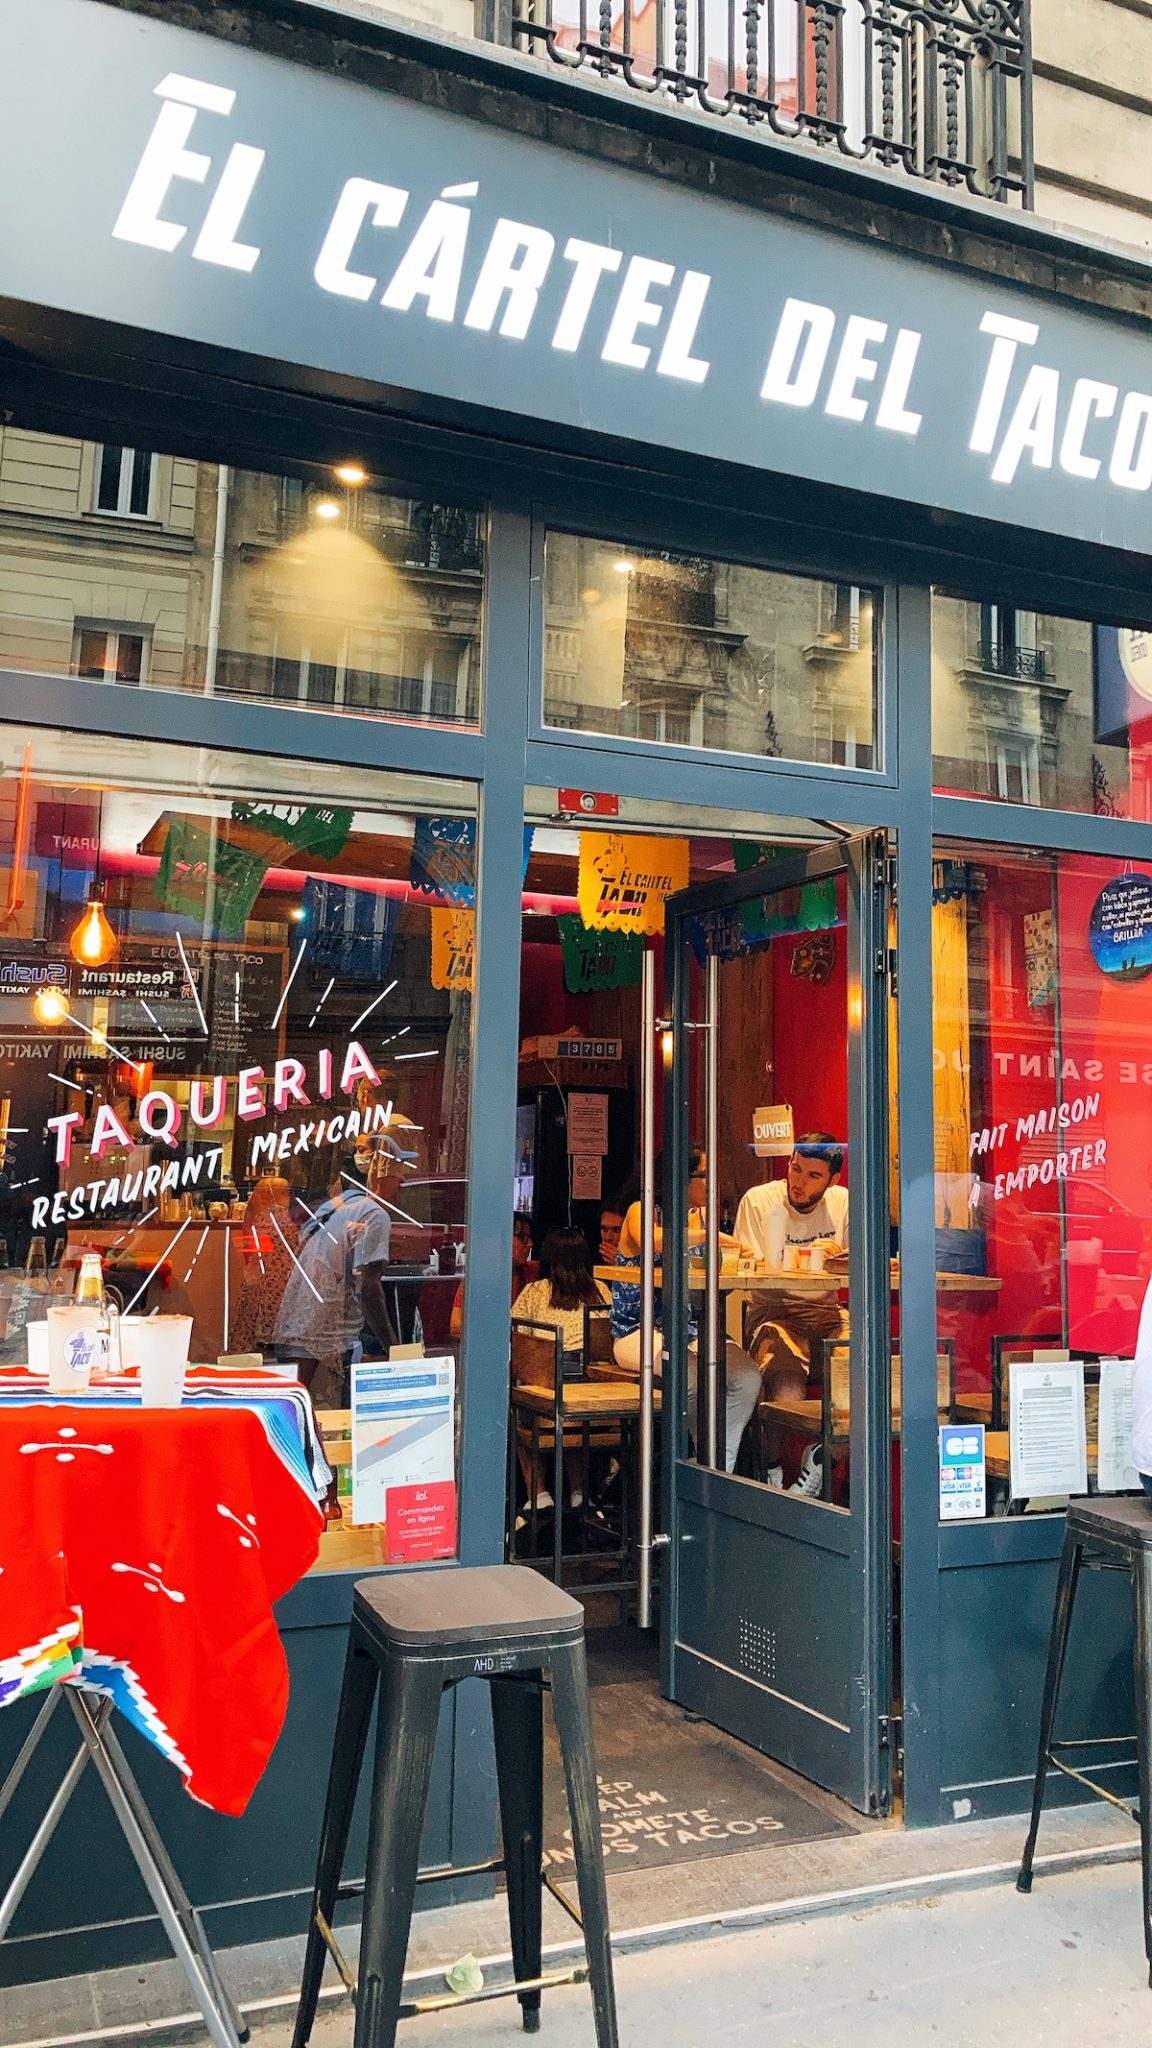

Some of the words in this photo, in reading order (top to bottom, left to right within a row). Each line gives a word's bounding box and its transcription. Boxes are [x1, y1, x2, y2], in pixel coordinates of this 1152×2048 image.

[112, 72, 266, 273] EL
[313, 180, 711, 384] CÁRTEL
[759, 297, 923, 436] DEL
[968, 310, 1152, 492] TACO
[572, 1043, 618, 1056] 3785
[48, 1041, 382, 1169] TAQUERIA
[754, 1121, 793, 1140] OUVERT
[969, 1123, 1008, 1158] FAIT
[1015, 1092, 1101, 1142] MAISON
[31, 1148, 224, 1229] RESTAURANT
[251, 1101, 394, 1168] MEXICAIN
[993, 1138, 1108, 1201] EMPORTER
[743, 1260, 751, 1270] 8
[415, 1490, 429, 1502] ici
[397, 1504, 445, 1517] Commandez
[418, 1514, 436, 1524] ligne
[644, 1815, 785, 1848] TACOS
